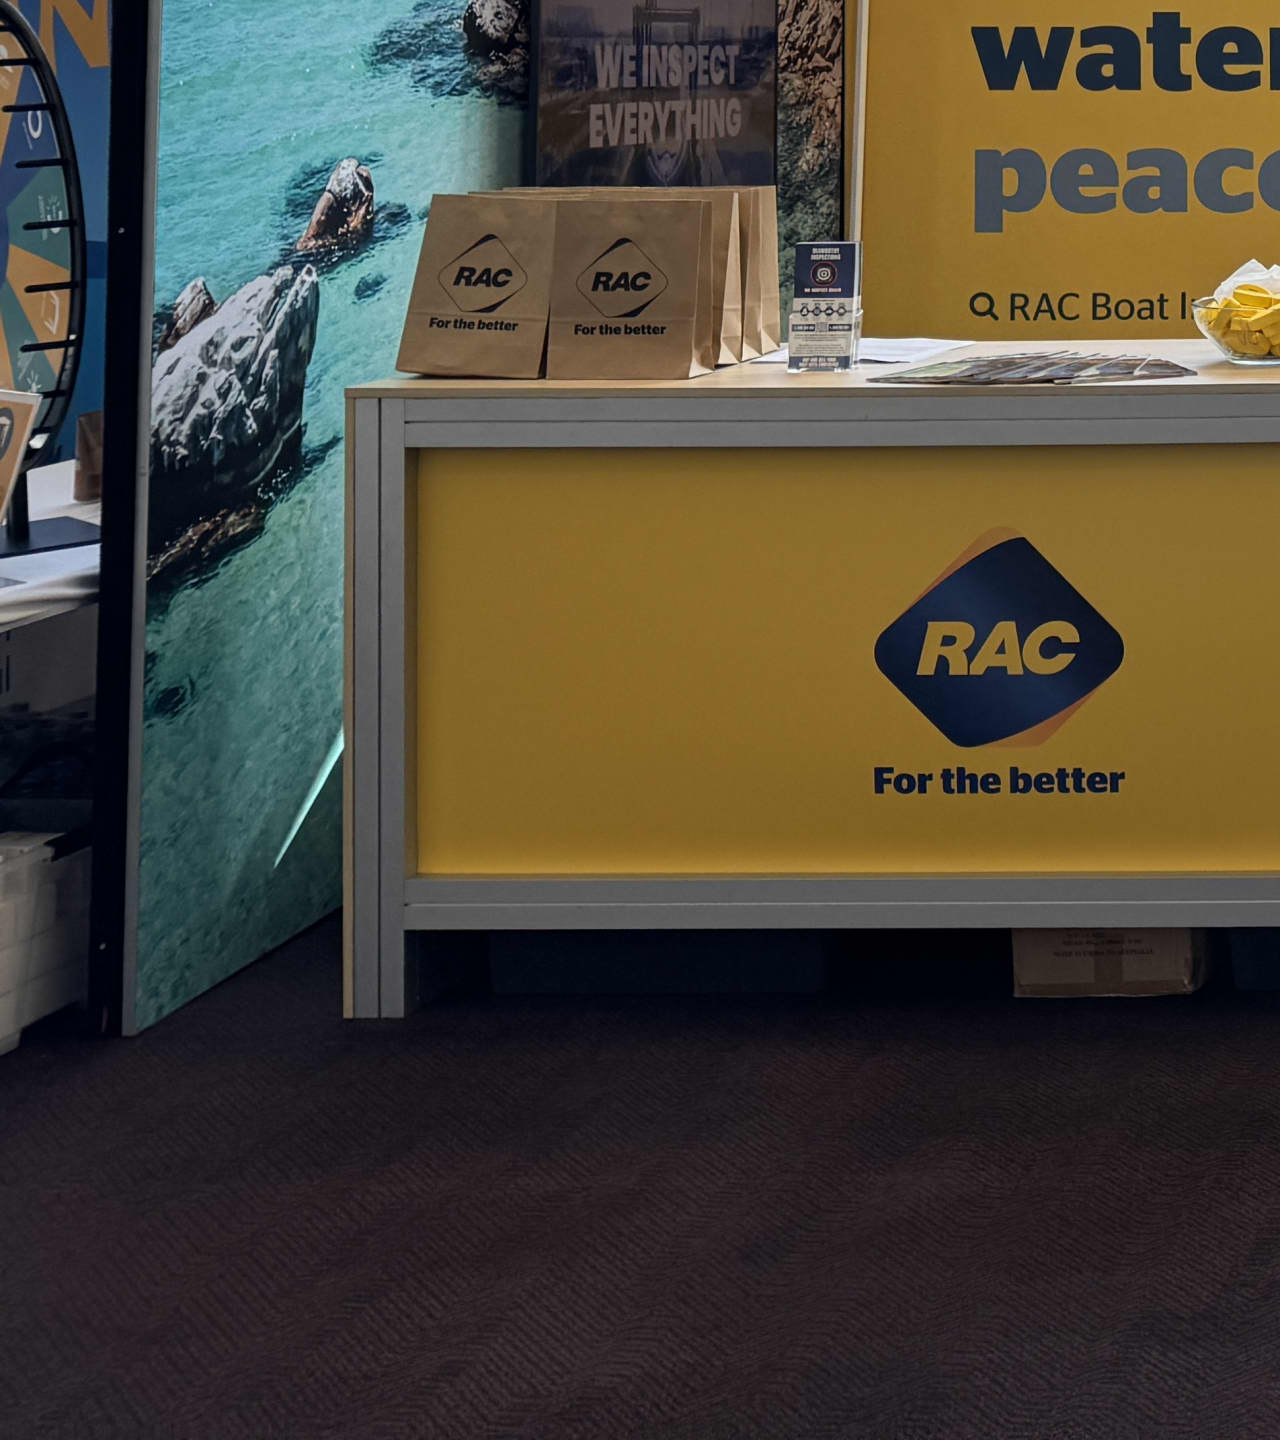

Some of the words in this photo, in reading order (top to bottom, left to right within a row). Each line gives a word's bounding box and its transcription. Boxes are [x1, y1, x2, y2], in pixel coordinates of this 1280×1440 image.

[594, 44, 637, 89] WE
[642, 43, 741, 88] INSPECT
[589, 97, 742, 149] EVERYTHING
[453, 265, 513, 288] RAC
[591, 271, 652, 292] RAC
[1009, 293, 1079, 321] RAC
[1092, 292, 1167, 321] Boat
[429, 317, 452, 330] For
[453, 317, 475, 331] the
[477, 319, 519, 332] better
[574, 324, 598, 335] For
[599, 324, 622, 335] the
[623, 323, 667, 336] better
[916, 620, 1081, 675] RAC
[873, 766, 933, 795] For
[940, 767, 1001, 795] the
[1009, 766, 1126, 794] better
